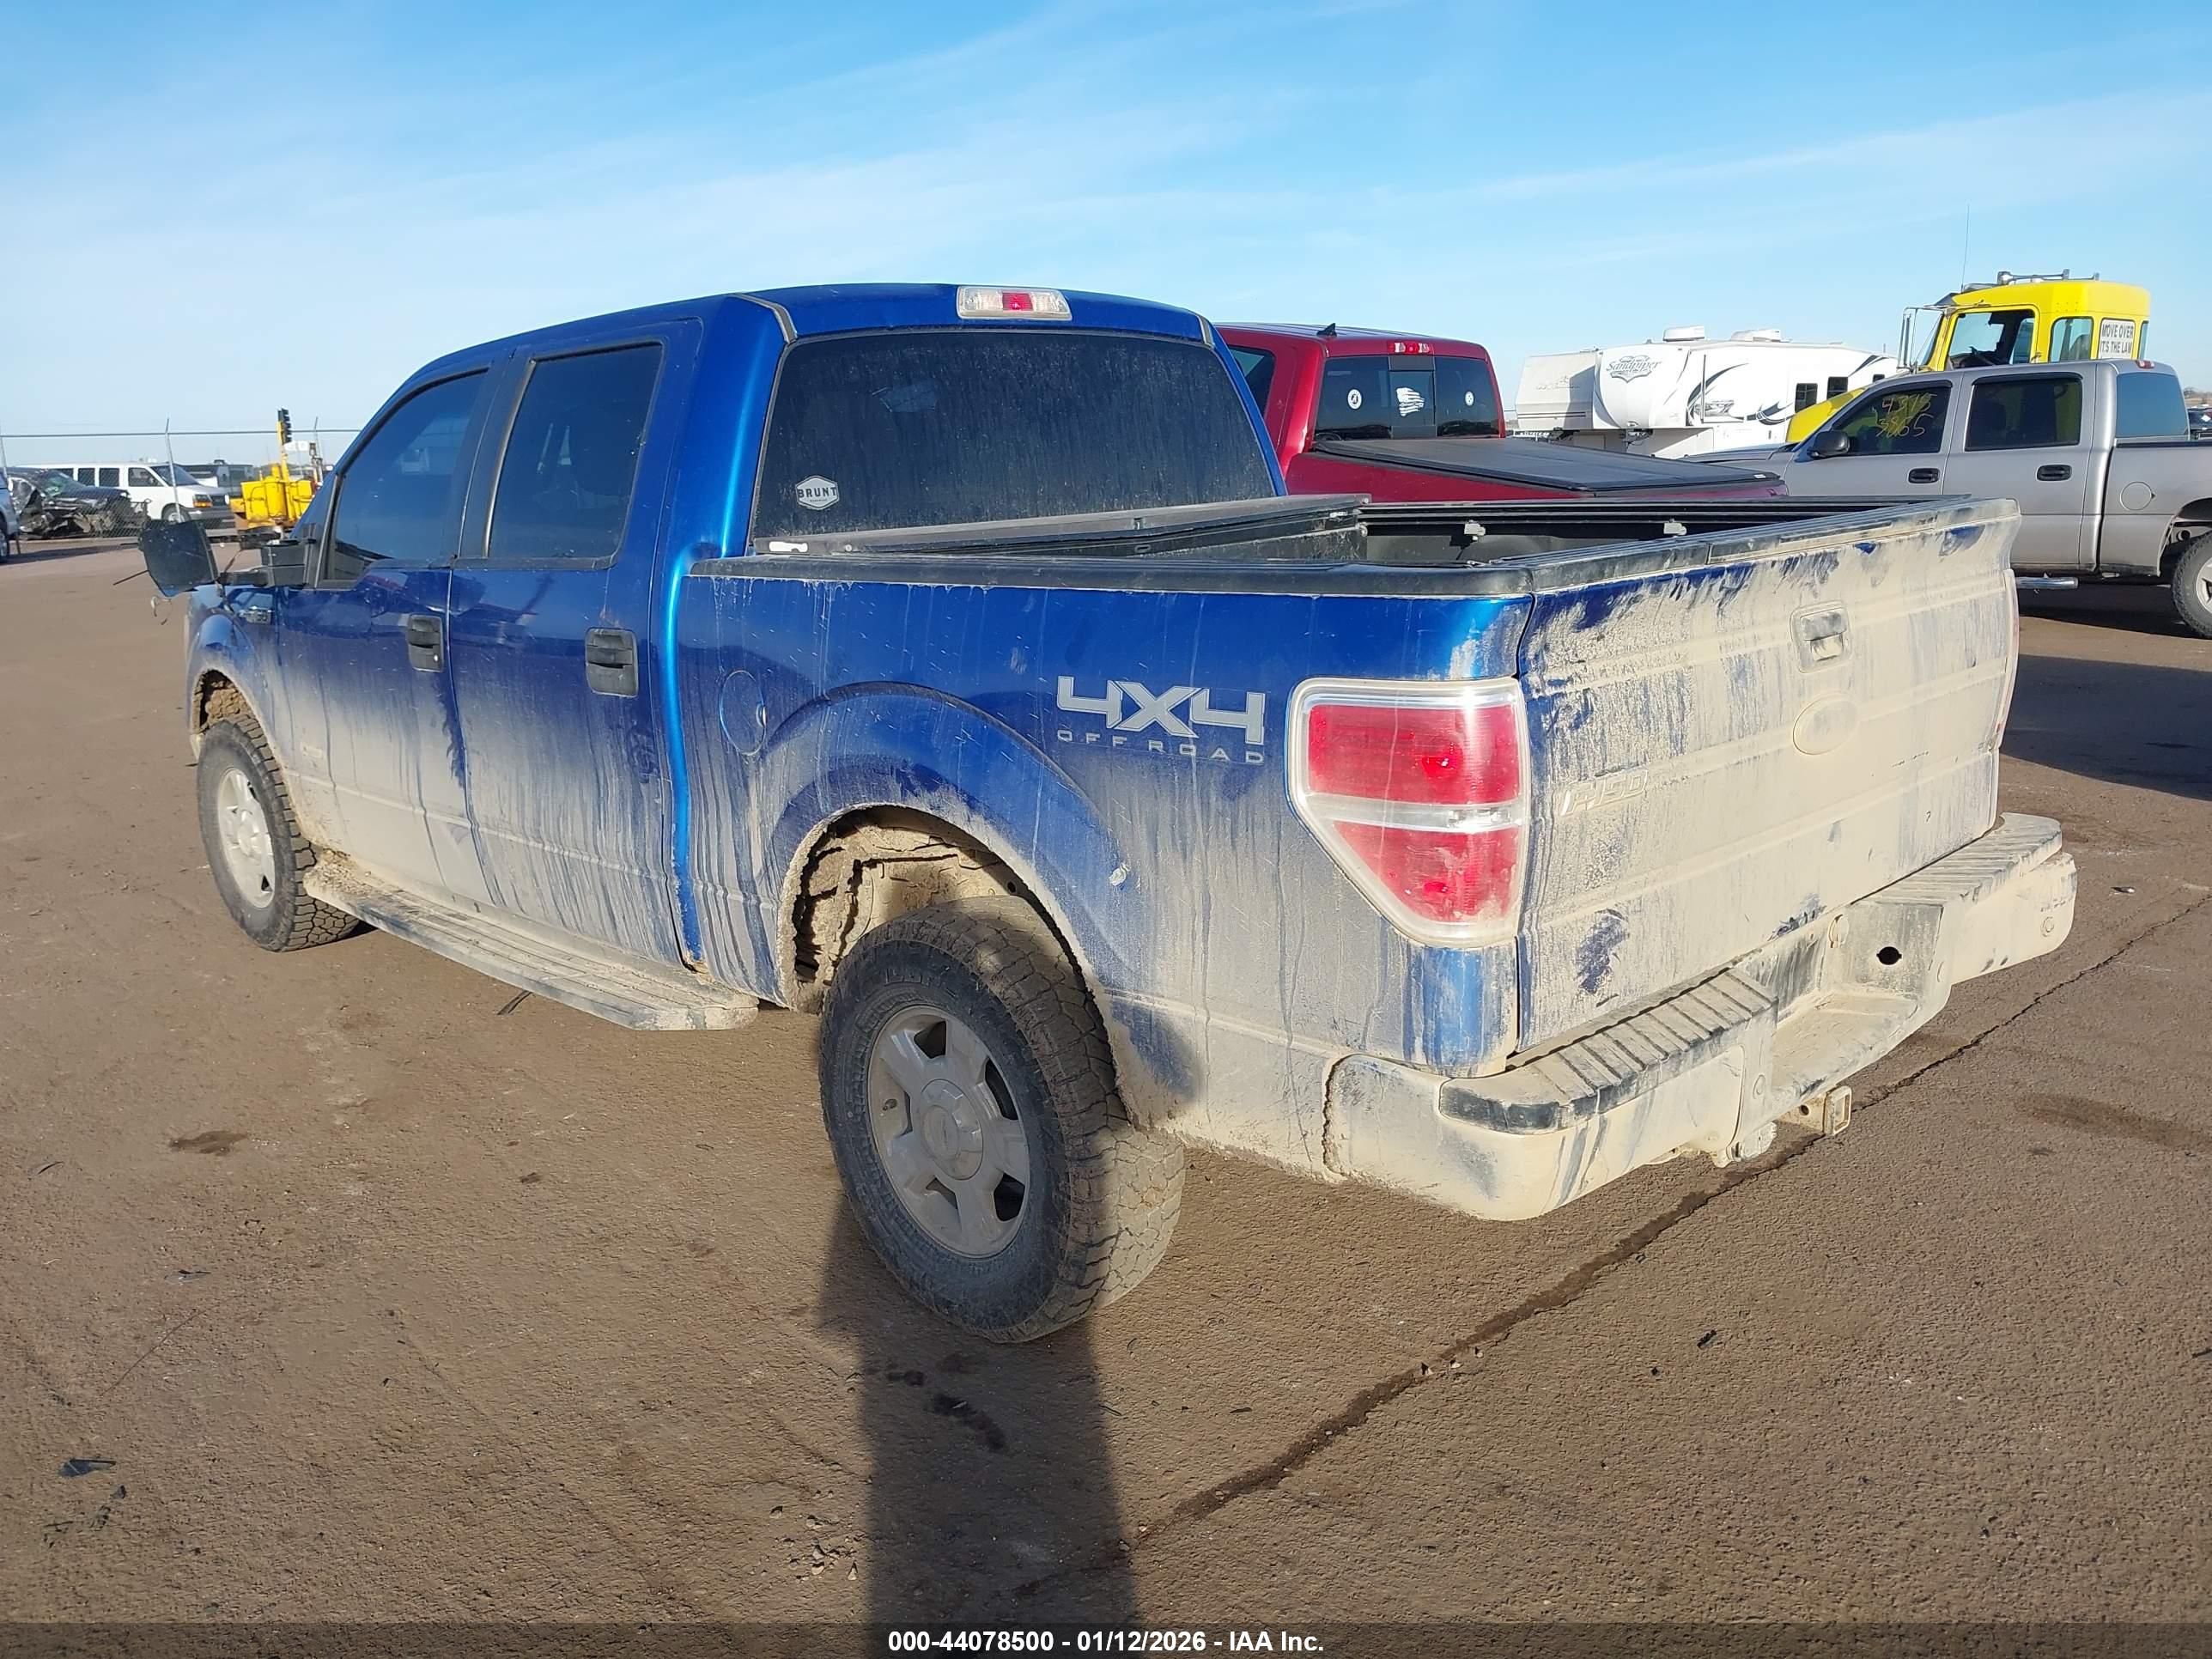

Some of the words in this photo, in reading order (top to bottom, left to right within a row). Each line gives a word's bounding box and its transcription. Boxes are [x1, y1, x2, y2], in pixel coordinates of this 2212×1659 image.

[2101, 324, 2118, 337] MOVE
[2118, 325, 2134, 338] OVER
[2111, 341, 2121, 353] THE
[2121, 341, 2133, 354] LAW
[797, 487, 836, 498] BRUNT
